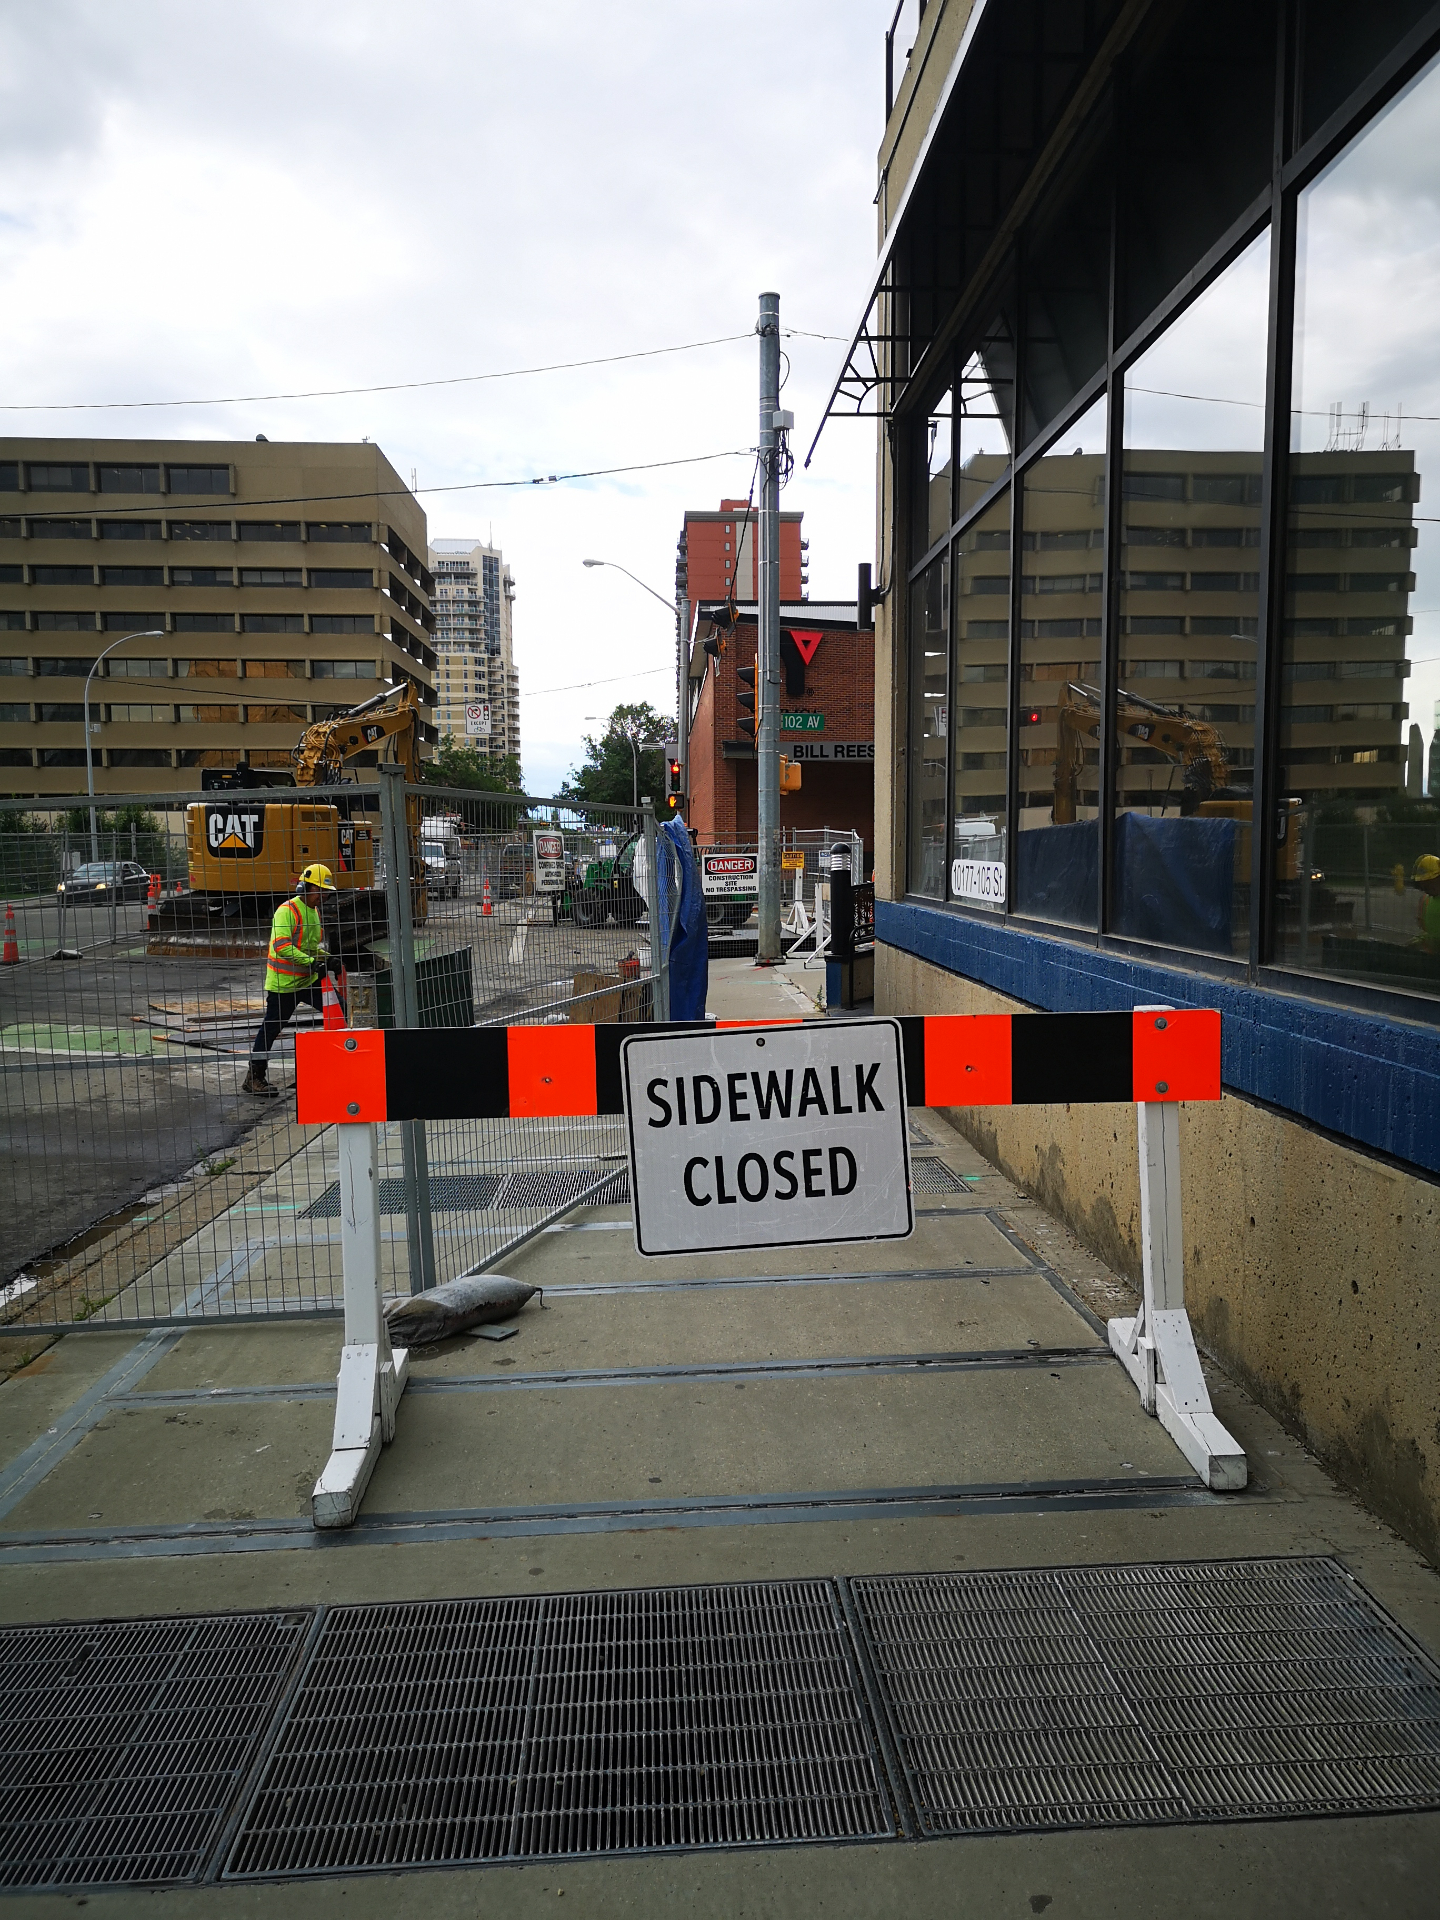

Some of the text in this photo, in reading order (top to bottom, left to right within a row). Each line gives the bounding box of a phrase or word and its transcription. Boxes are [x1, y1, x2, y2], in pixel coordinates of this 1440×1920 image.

[784, 715, 820, 729] 102 AV
[367, 725, 378, 742] CAT
[793, 744, 875, 759] BILL REES
[209, 814, 258, 848] CAT
[341, 829, 354, 845] CAT
[540, 841, 561, 853] DANGER
[710, 860, 752, 871] DANGER
[708, 874, 754, 882] CONSTRUCTION
[953, 864, 1005, 897] 10177-105 St.
[716, 885, 757, 893] TRESPASSING
[646, 1062, 885, 1129] SIDEWALK
[683, 1146, 858, 1207] CLOSED
